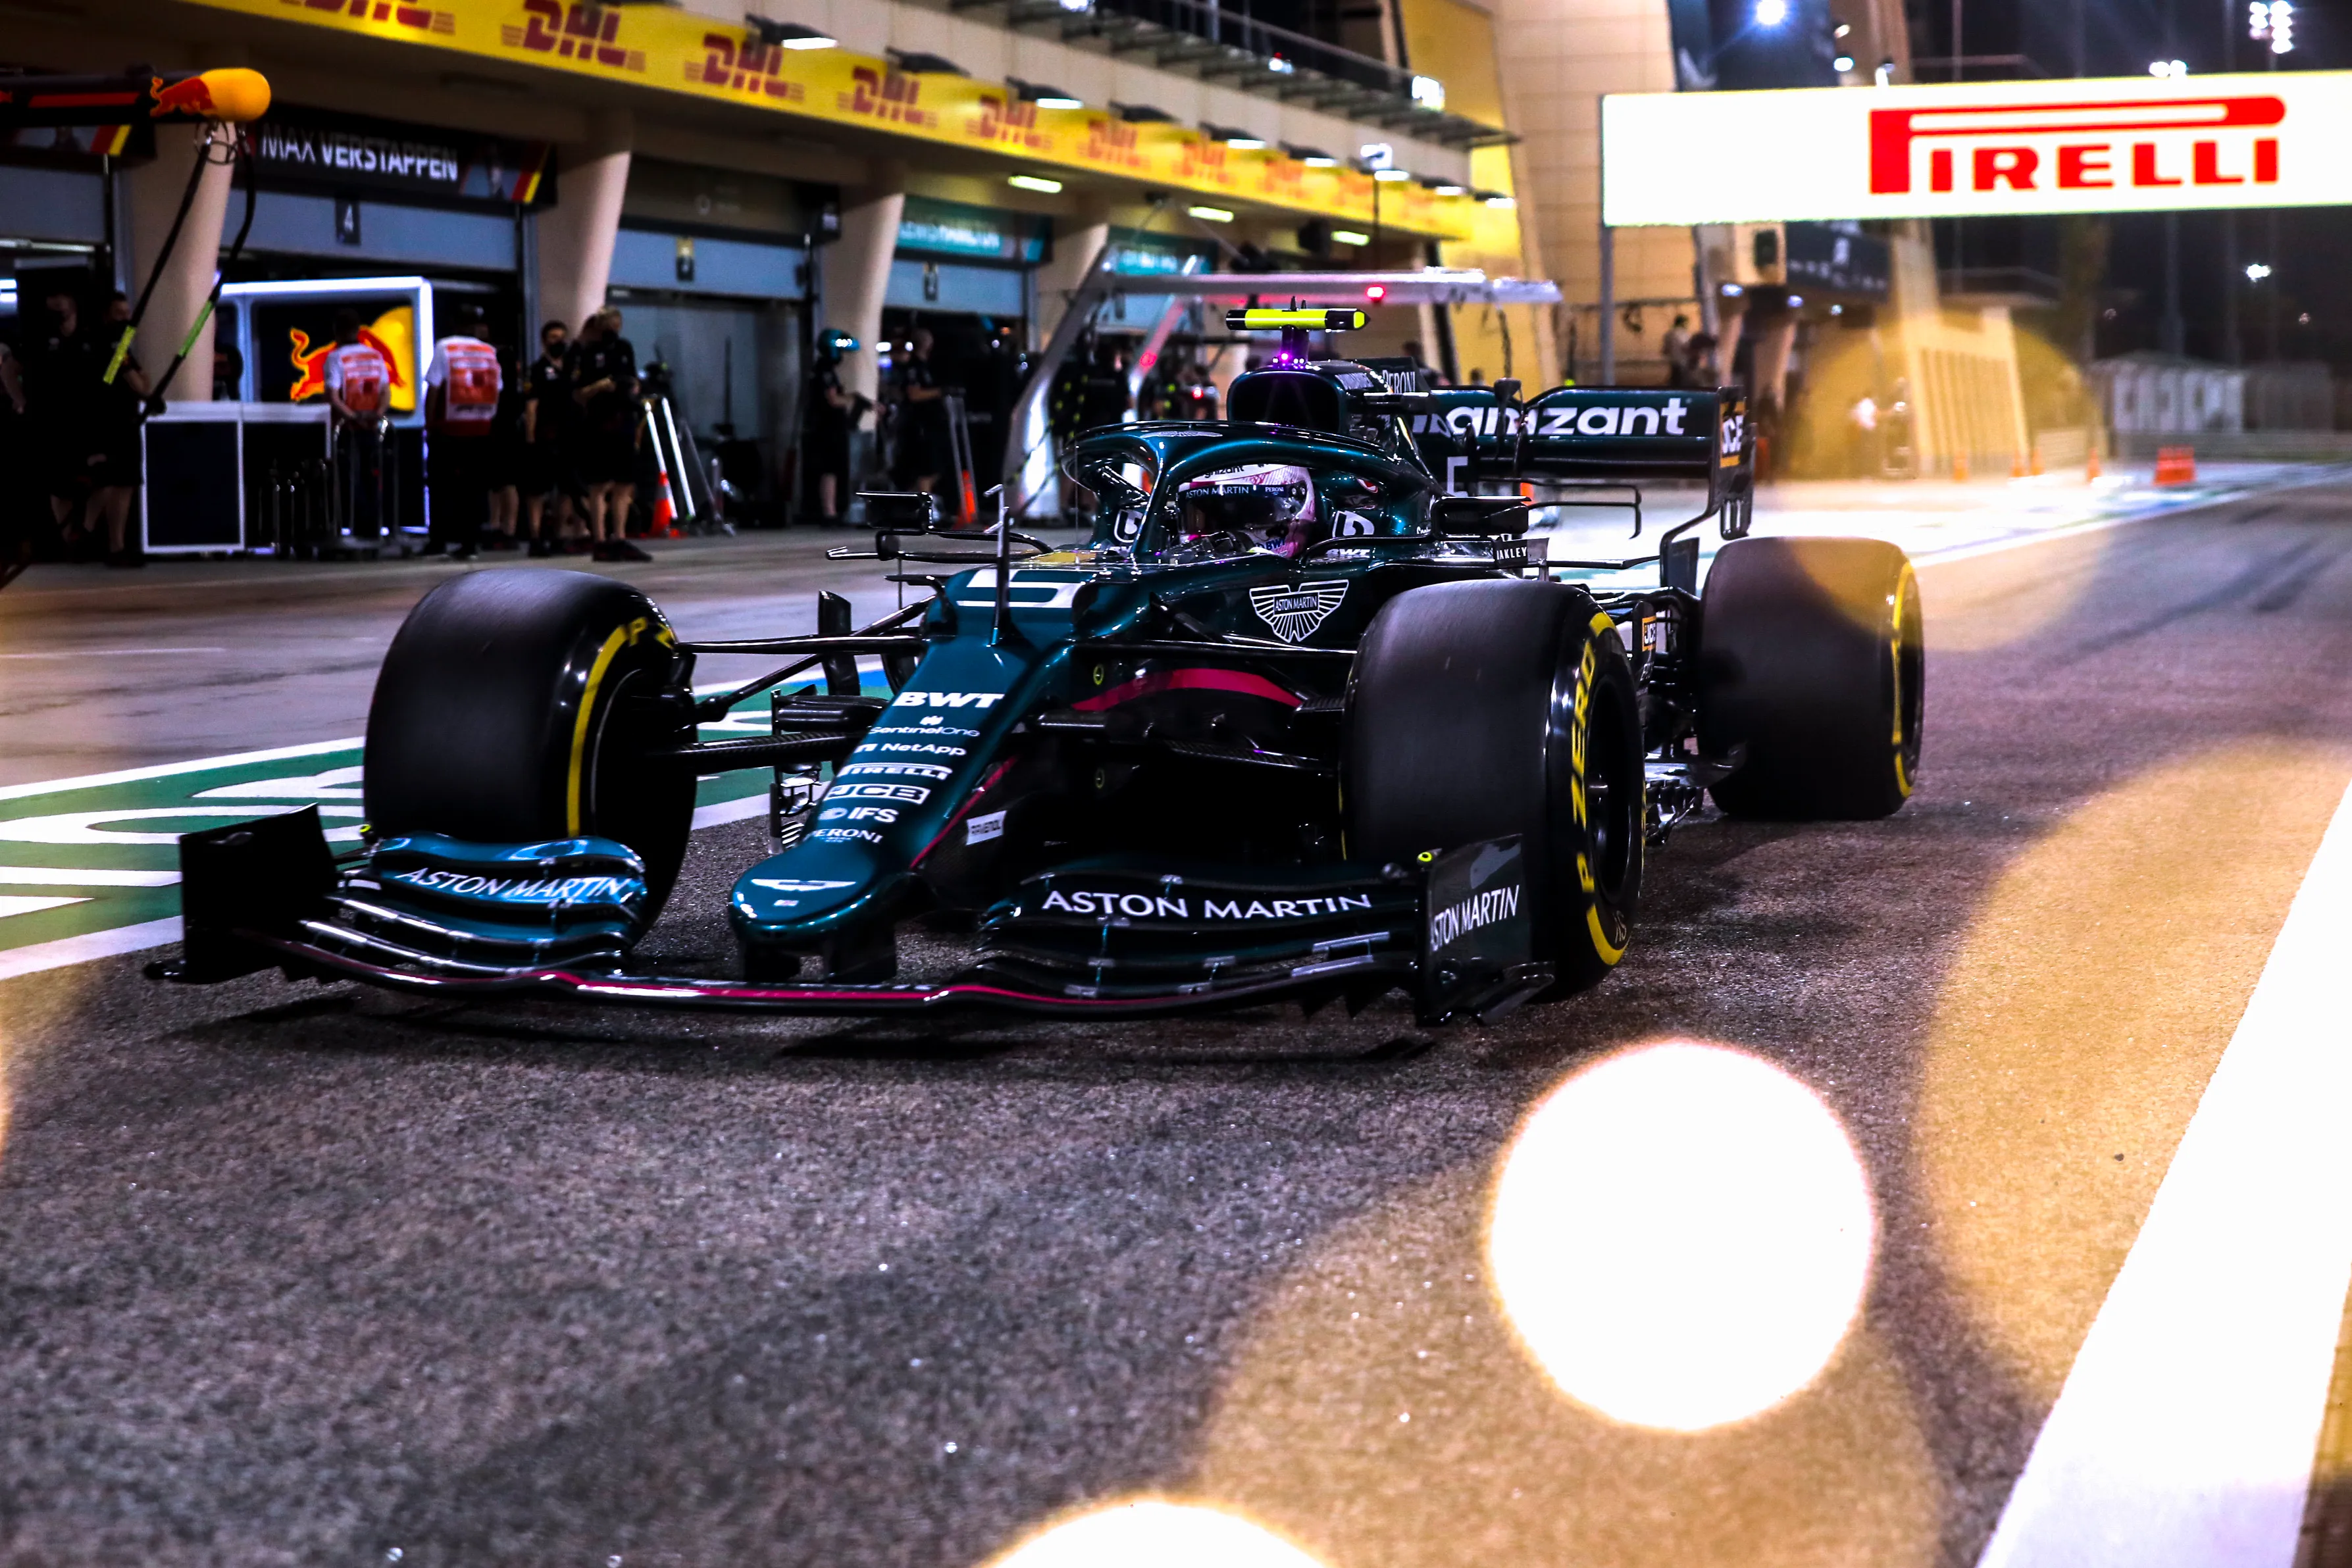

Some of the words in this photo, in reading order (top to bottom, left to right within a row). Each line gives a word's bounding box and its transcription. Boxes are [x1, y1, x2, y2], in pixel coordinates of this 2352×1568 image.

[523, 0, 626, 66] DHL
[703, 33, 788, 97] DHL
[852, 66, 925, 124] DHL
[261, 122, 316, 163] MAX
[320, 130, 459, 182] VERSTAPPEN
[1869, 95, 2286, 195] PIRELLI
[1186, 488, 1209, 499] ASTON
[1212, 486, 1250, 495] MARTIN
[1275, 598, 1292, 611] ASTON
[1293, 595, 1317, 609] MARTIN
[892, 692, 1006, 708] BWT
[869, 726, 981, 737] SentinelOne
[881, 743, 967, 756] NetApp
[836, 762, 953, 780] PIRELLI
[825, 784, 927, 803] JCB
[848, 807, 900, 823] IFS
[394, 867, 513, 896] ASTON
[500, 876, 633, 899] MARTIN
[1042, 890, 1189, 919] ASTON
[1204, 894, 1372, 919] MARTIN
[1461, 884, 1520, 934] MARTIN
